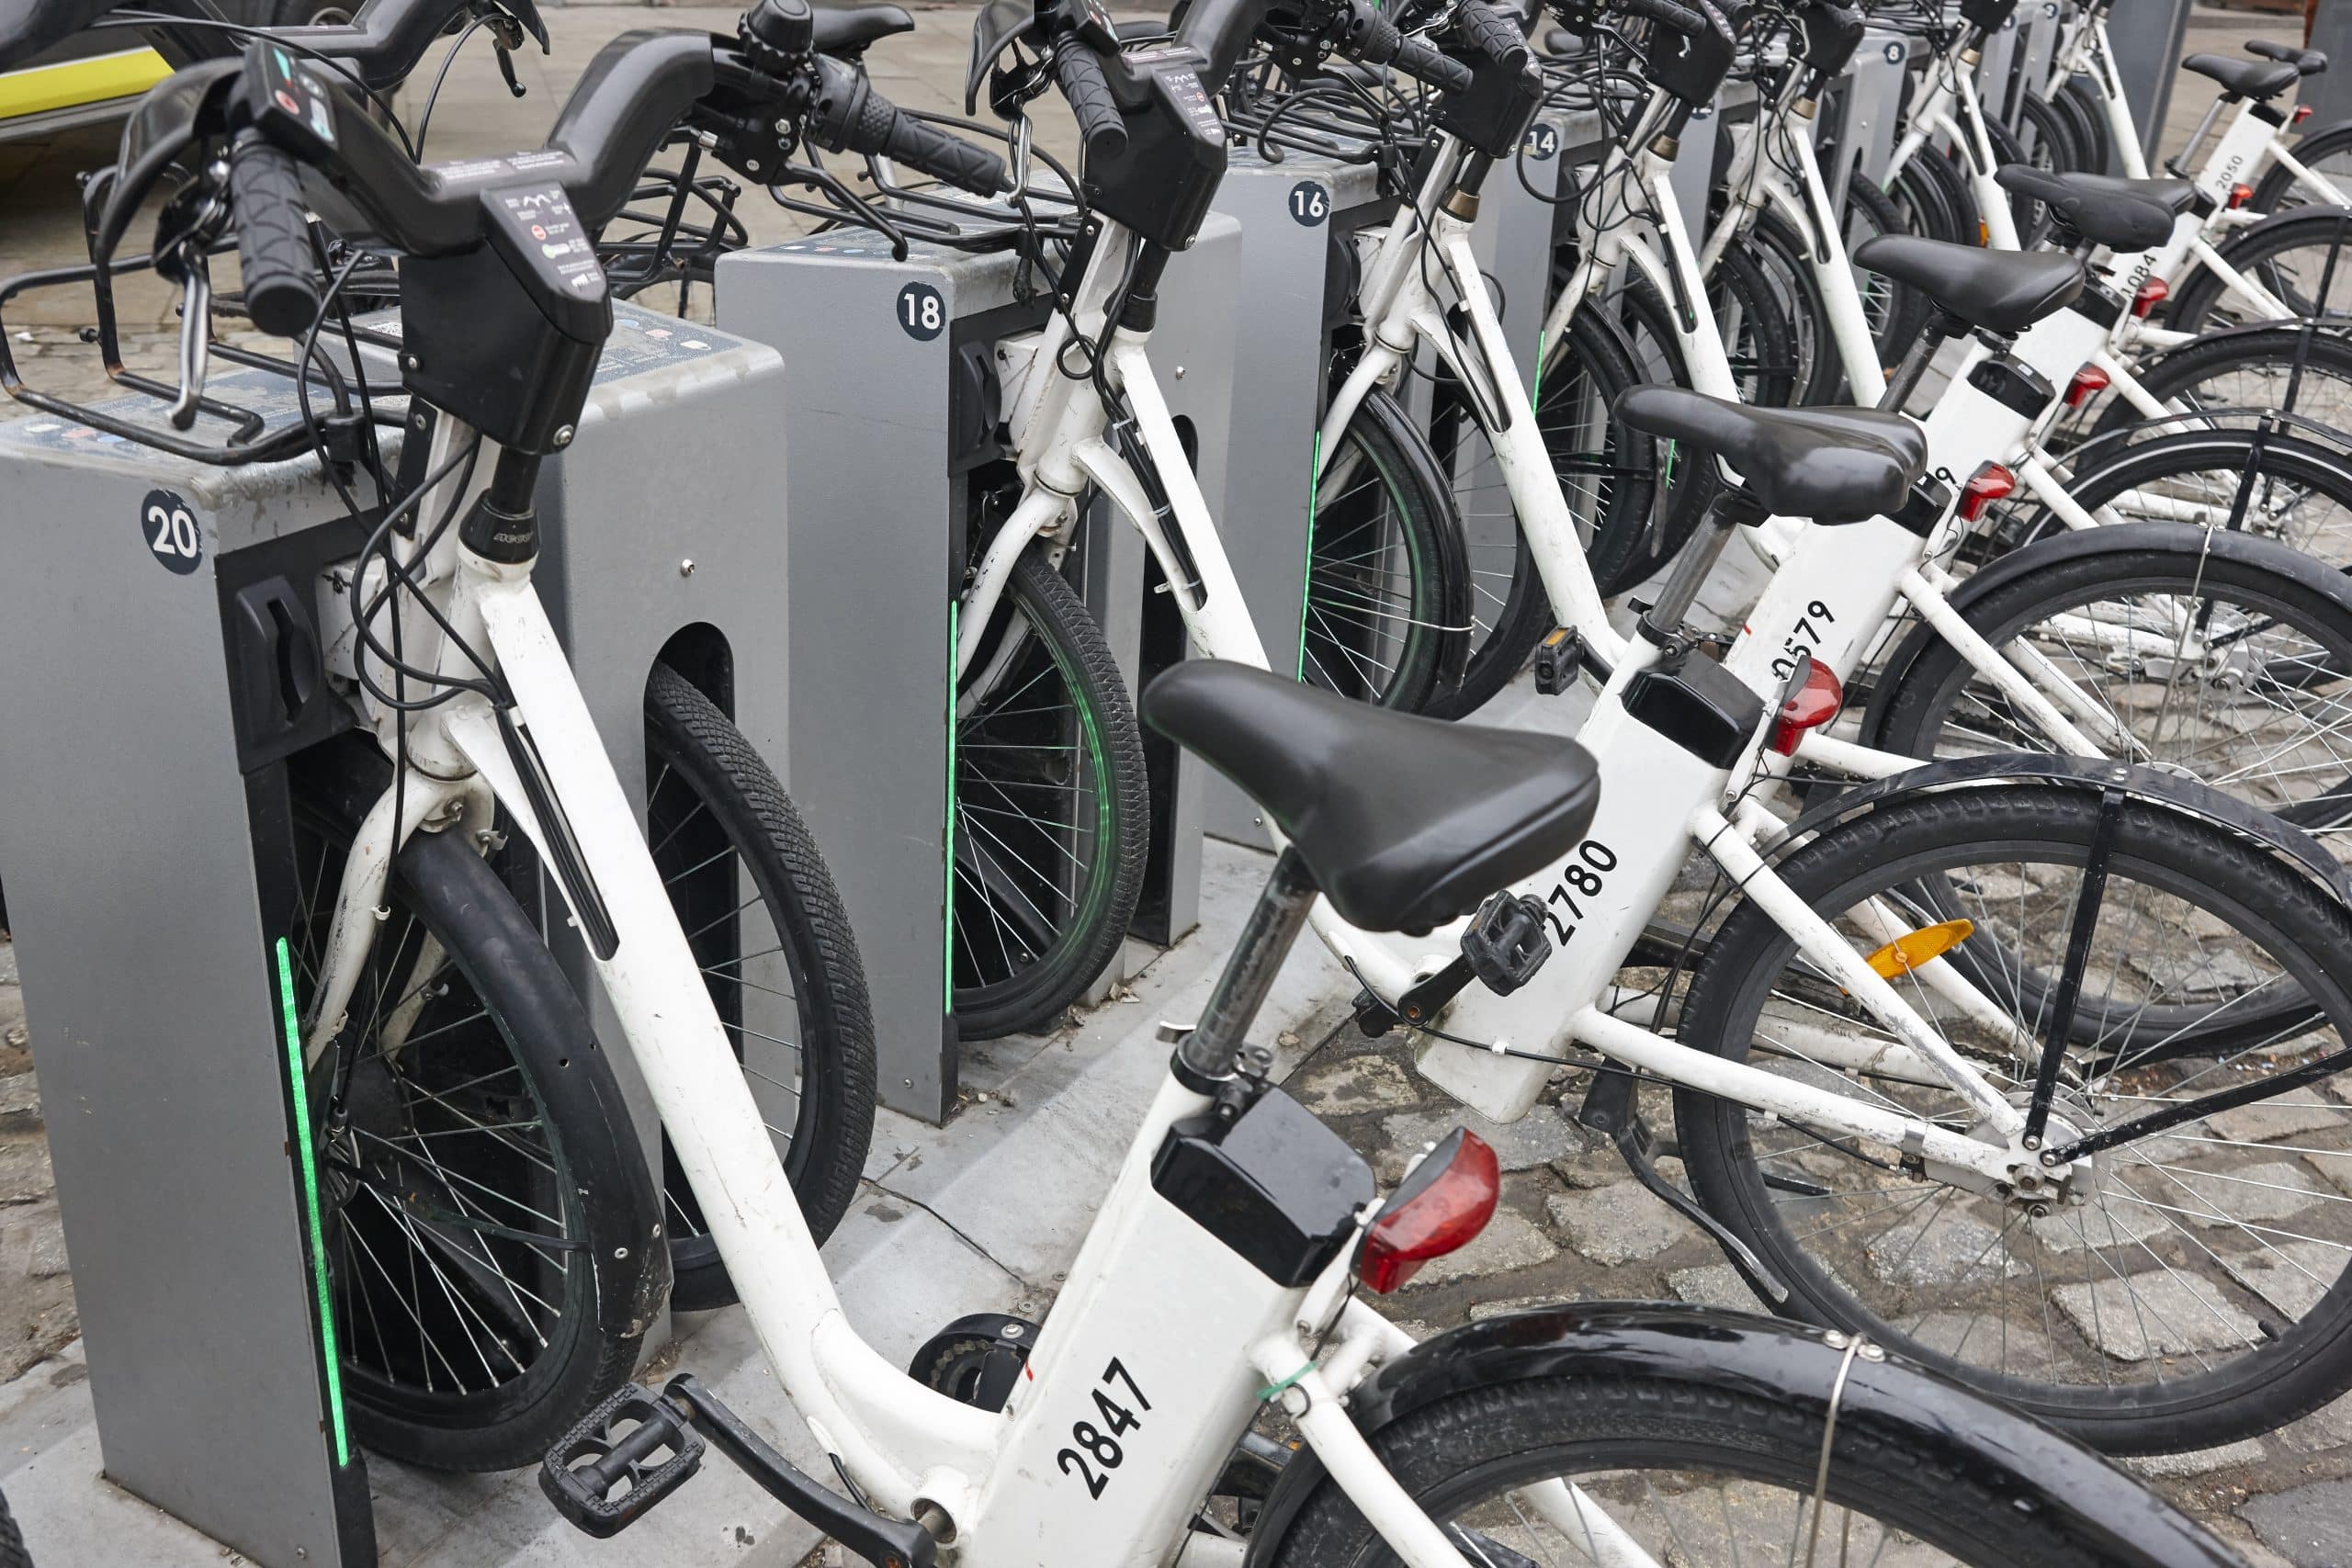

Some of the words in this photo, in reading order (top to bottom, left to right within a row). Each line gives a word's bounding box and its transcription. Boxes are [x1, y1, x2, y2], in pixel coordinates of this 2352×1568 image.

[1887, 45, 1899, 61] 8
[1528, 130, 1555, 152] 14
[2214, 155, 2244, 189] 2050
[1294, 190, 1325, 218] 16
[903, 292, 941, 330] 18
[148, 505, 198, 558] 20
[1543, 840, 1618, 947] 2780
[1057, 1356, 1152, 1501] 2847
